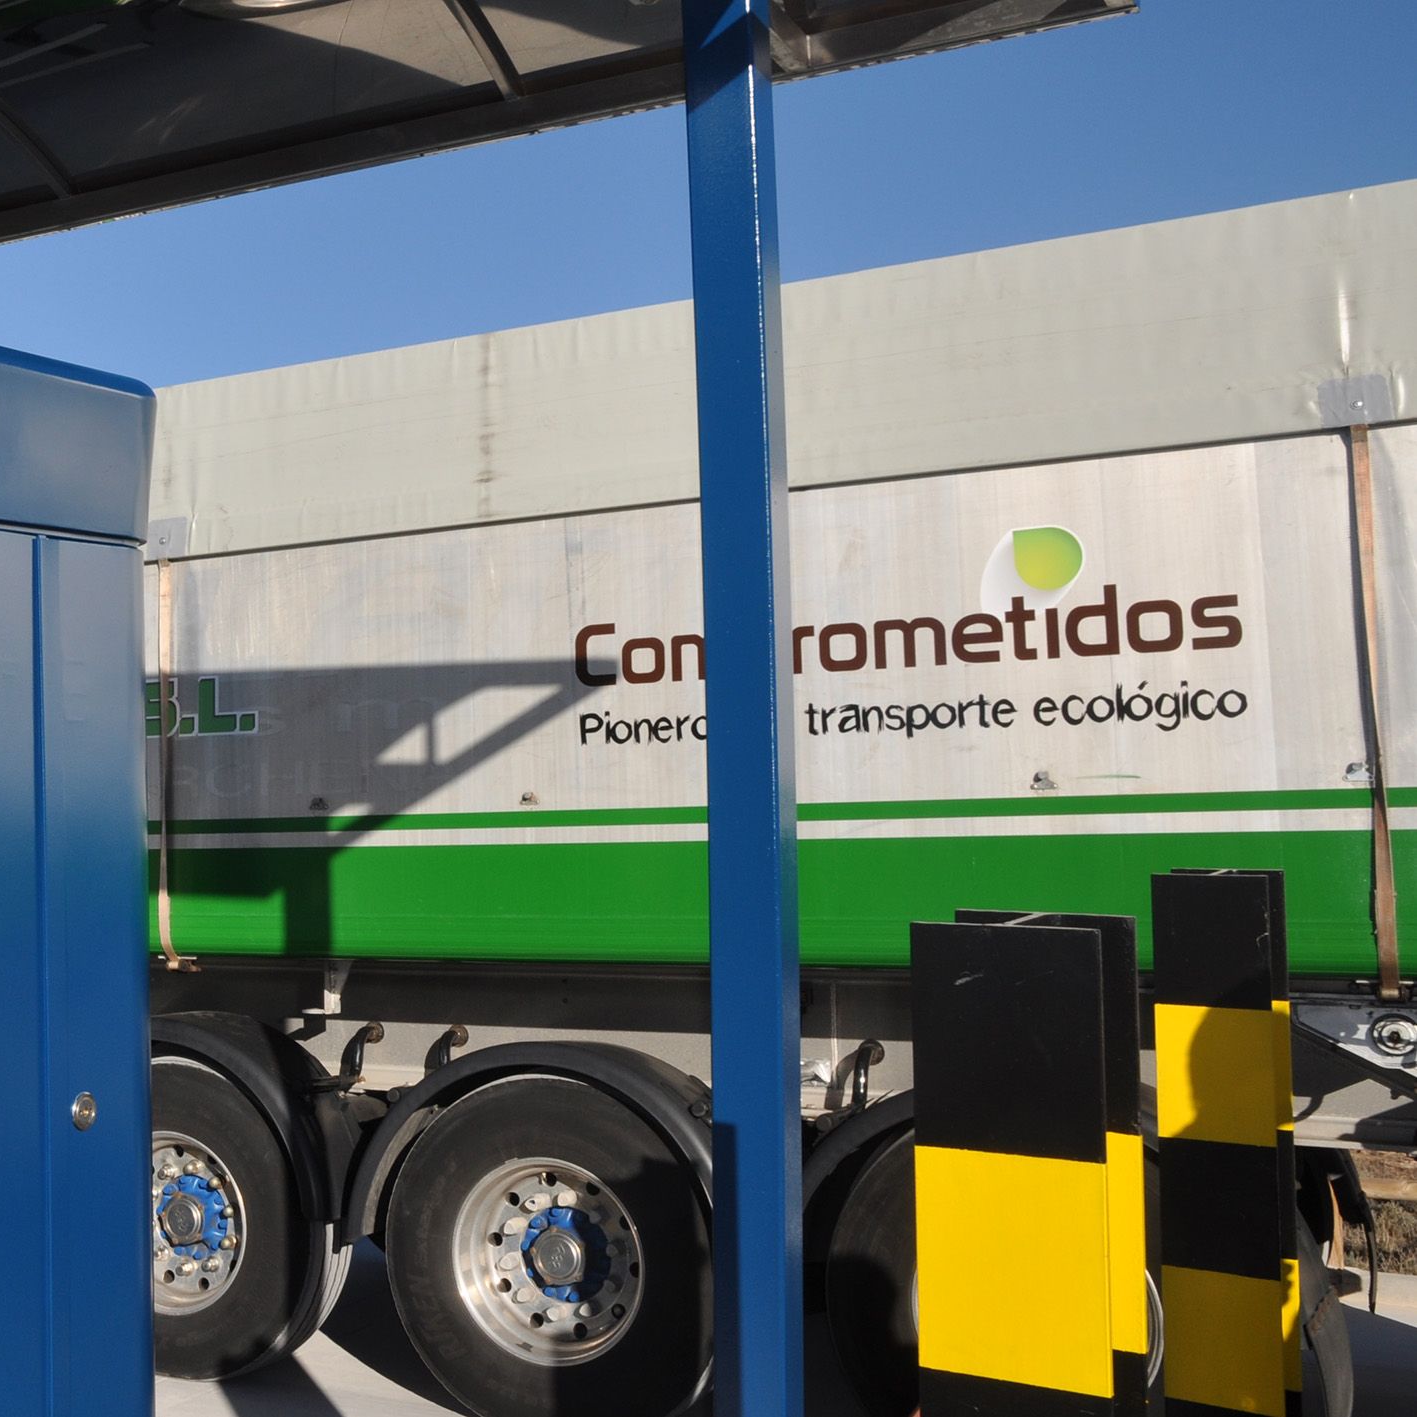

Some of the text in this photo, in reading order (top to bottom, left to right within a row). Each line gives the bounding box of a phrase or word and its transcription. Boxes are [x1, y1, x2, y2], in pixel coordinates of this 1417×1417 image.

[575, 584, 1243, 687] Comrometidos
[579, 680, 1248, 746] Pionero transporte ecológico
